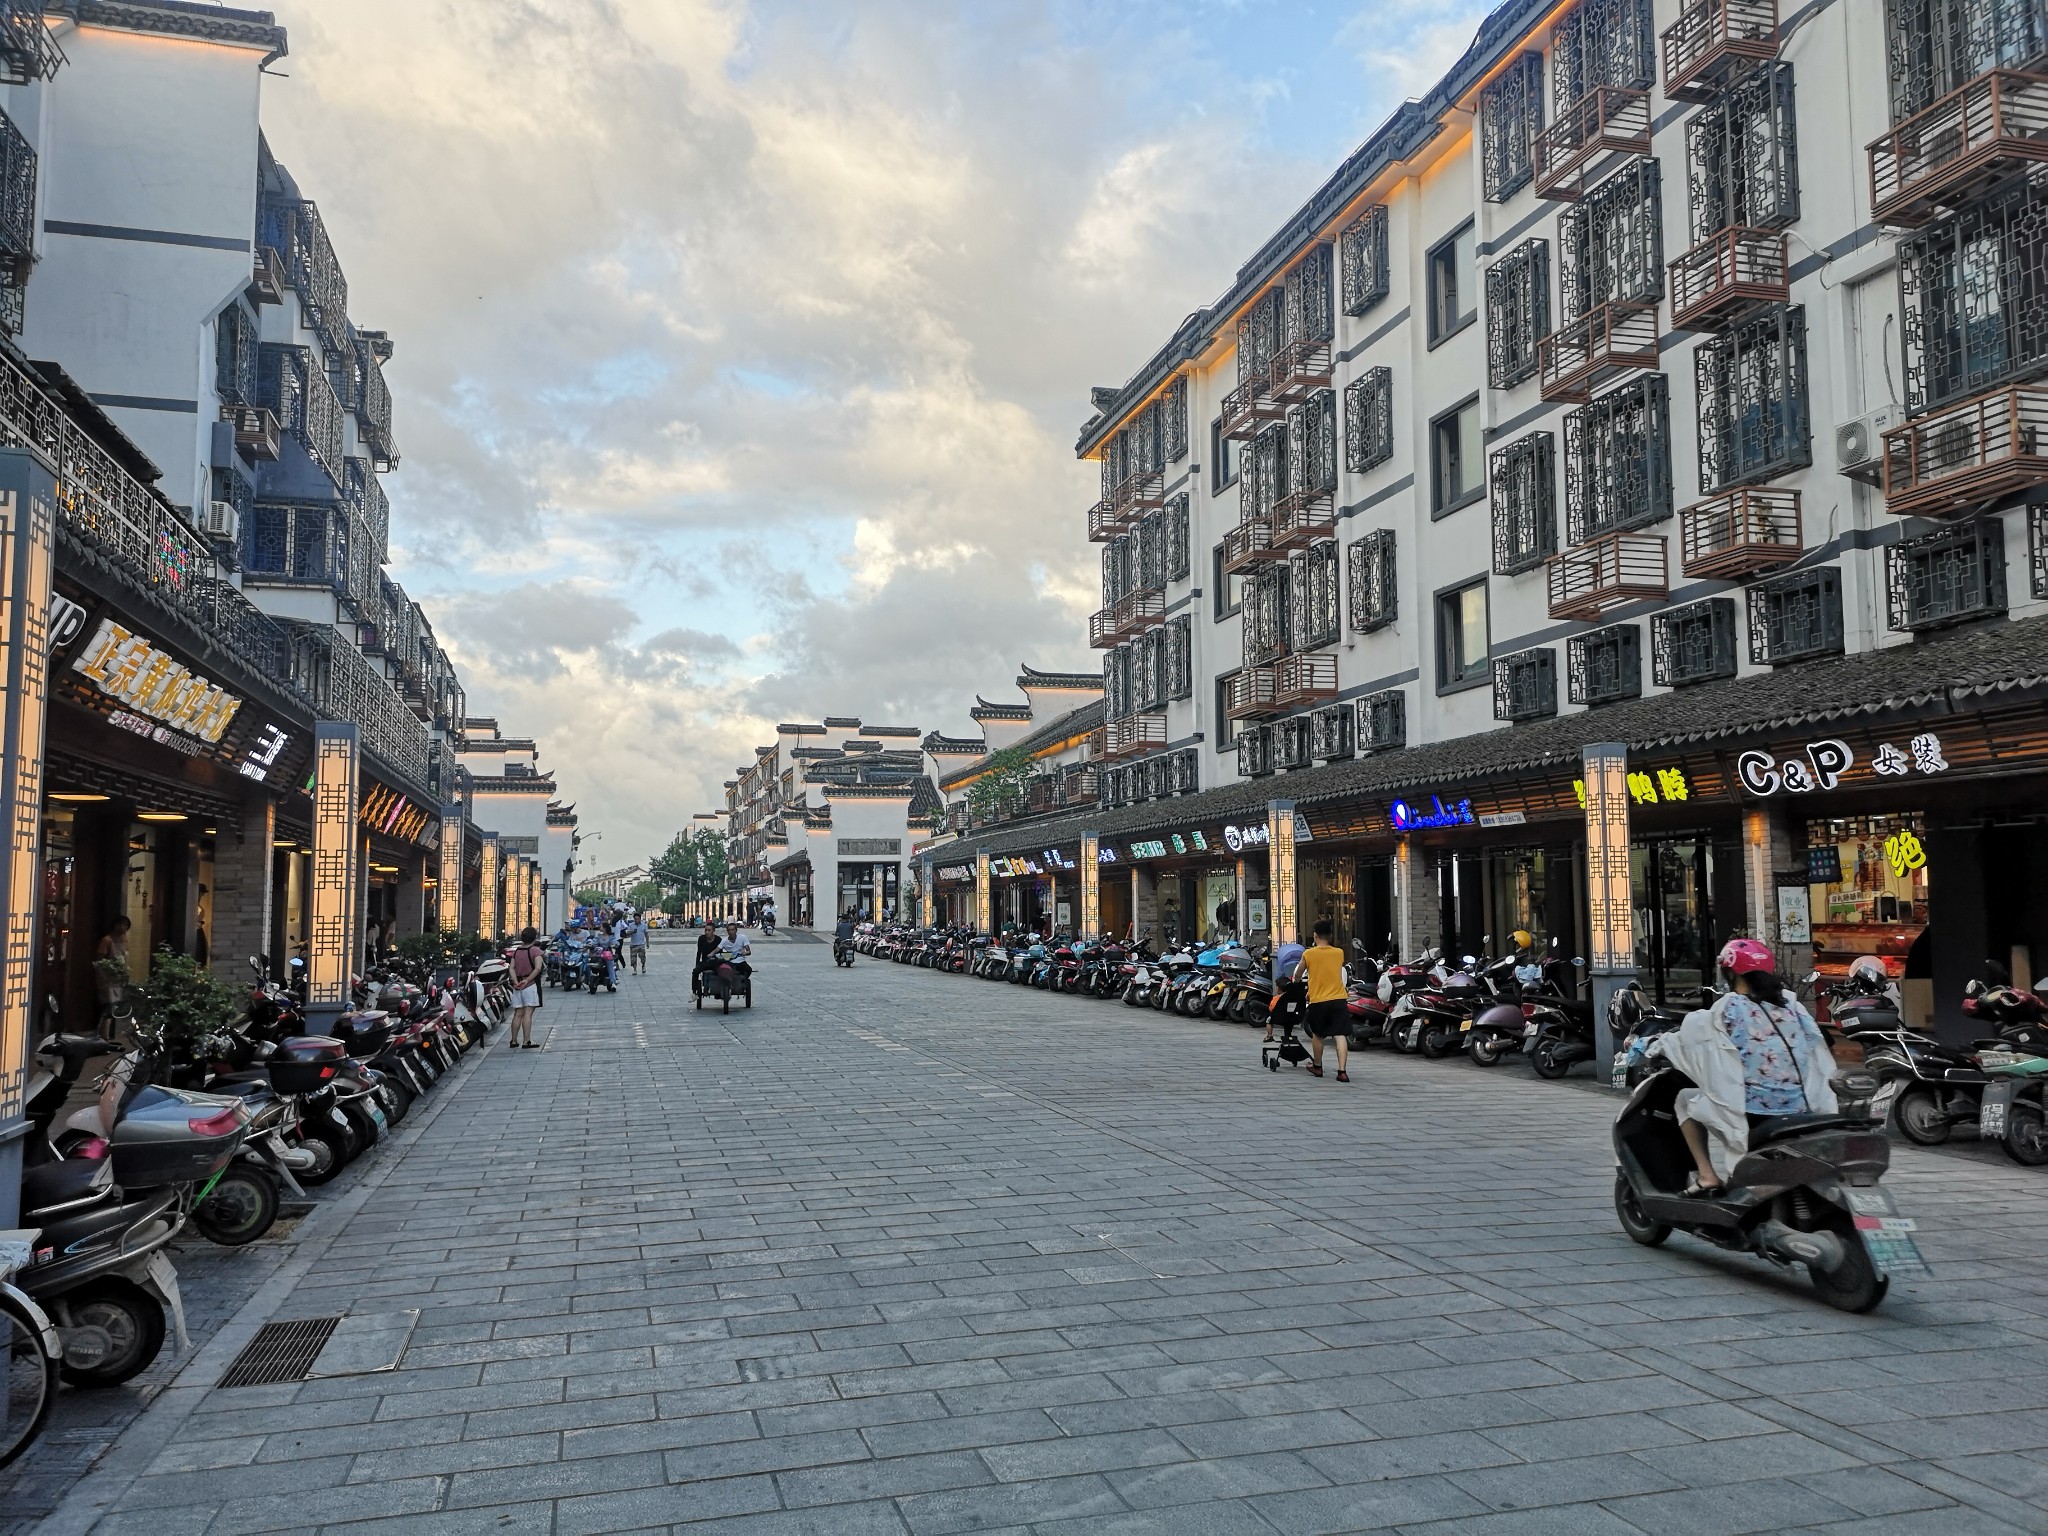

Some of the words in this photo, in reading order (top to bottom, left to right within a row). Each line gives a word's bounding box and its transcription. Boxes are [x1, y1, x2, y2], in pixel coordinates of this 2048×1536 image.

[73, 618, 243, 743] 正宗黄焖鸡米饭
[1738, 739, 1853, 796] C&P
[1872, 733, 1948, 775] 女装
[1884, 828, 1927, 877] 绝
